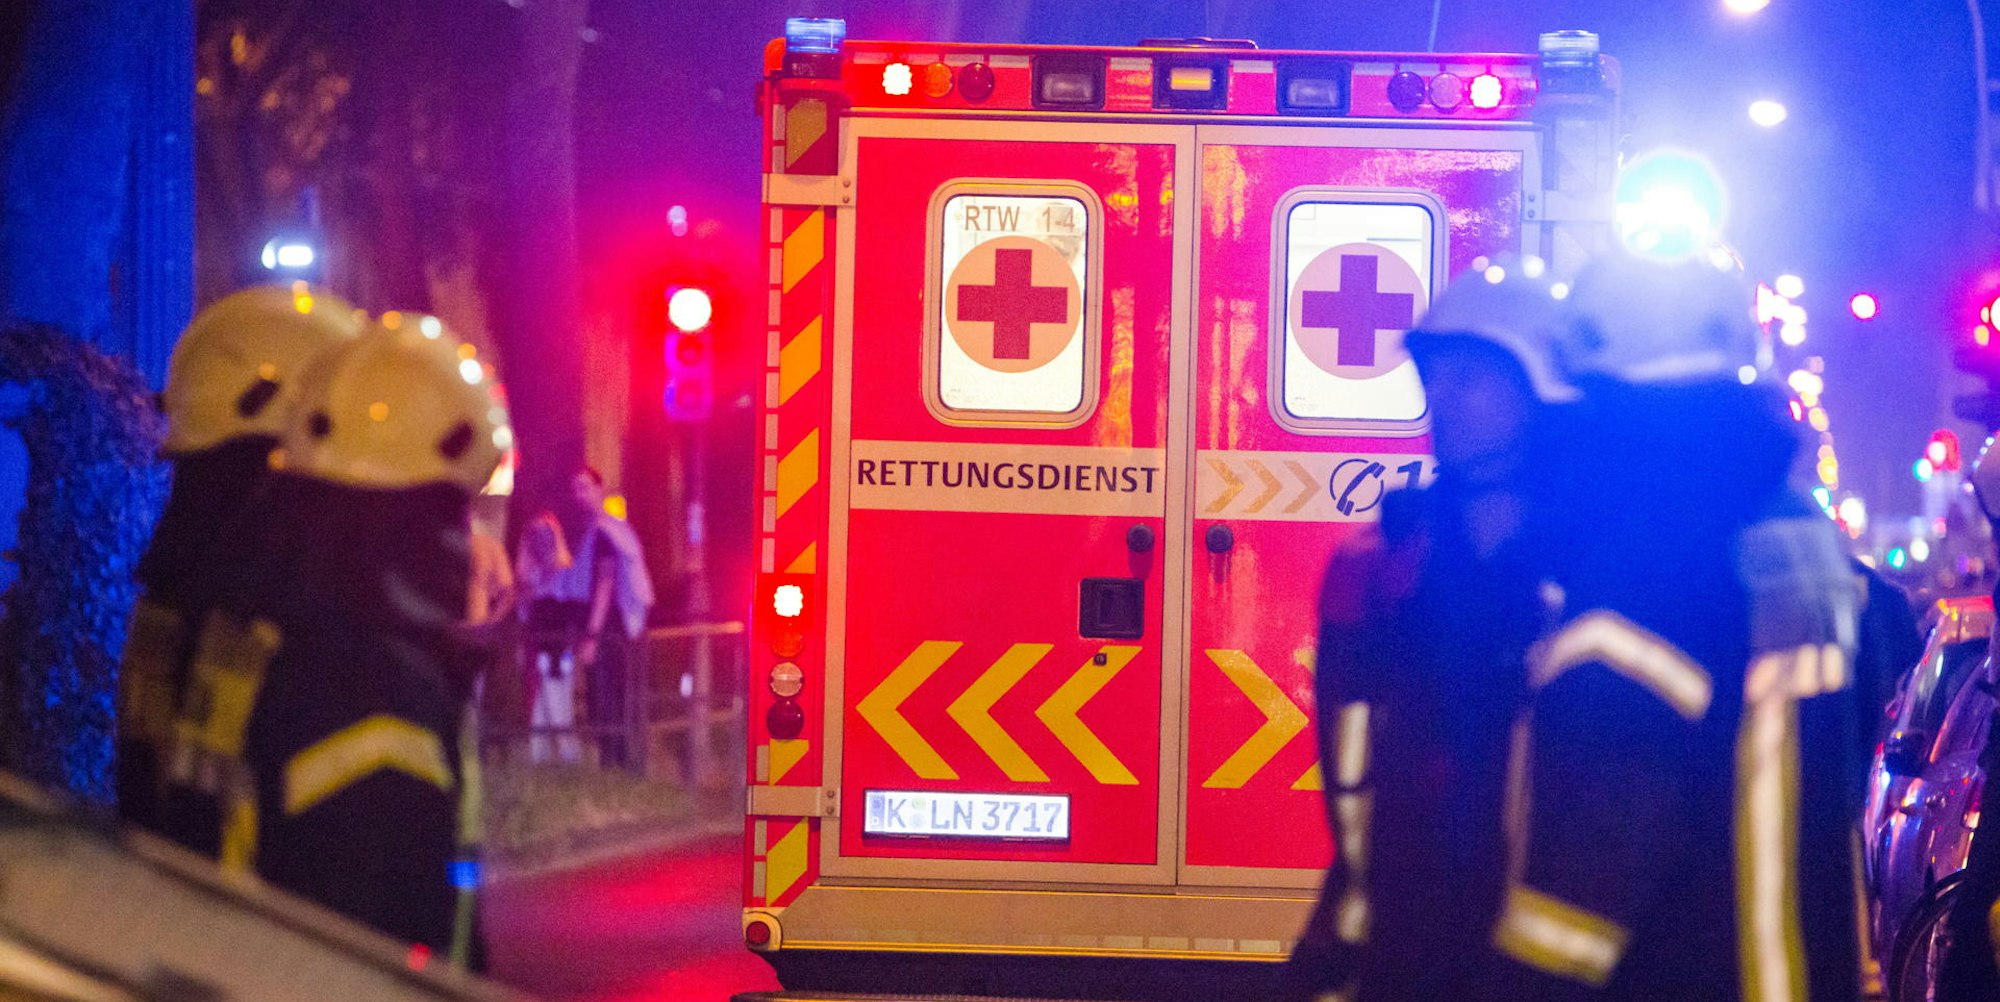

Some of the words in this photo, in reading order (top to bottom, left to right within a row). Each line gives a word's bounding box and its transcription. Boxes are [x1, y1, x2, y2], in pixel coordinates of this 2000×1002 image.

[965, 205, 1020, 231] RTW
[1042, 206, 1075, 232] 1-4
[857, 459, 1159, 493] RETTUNGSDIENST
[888, 798, 907, 828] K
[931, 800, 973, 830] LN
[982, 800, 1062, 832] 3717
